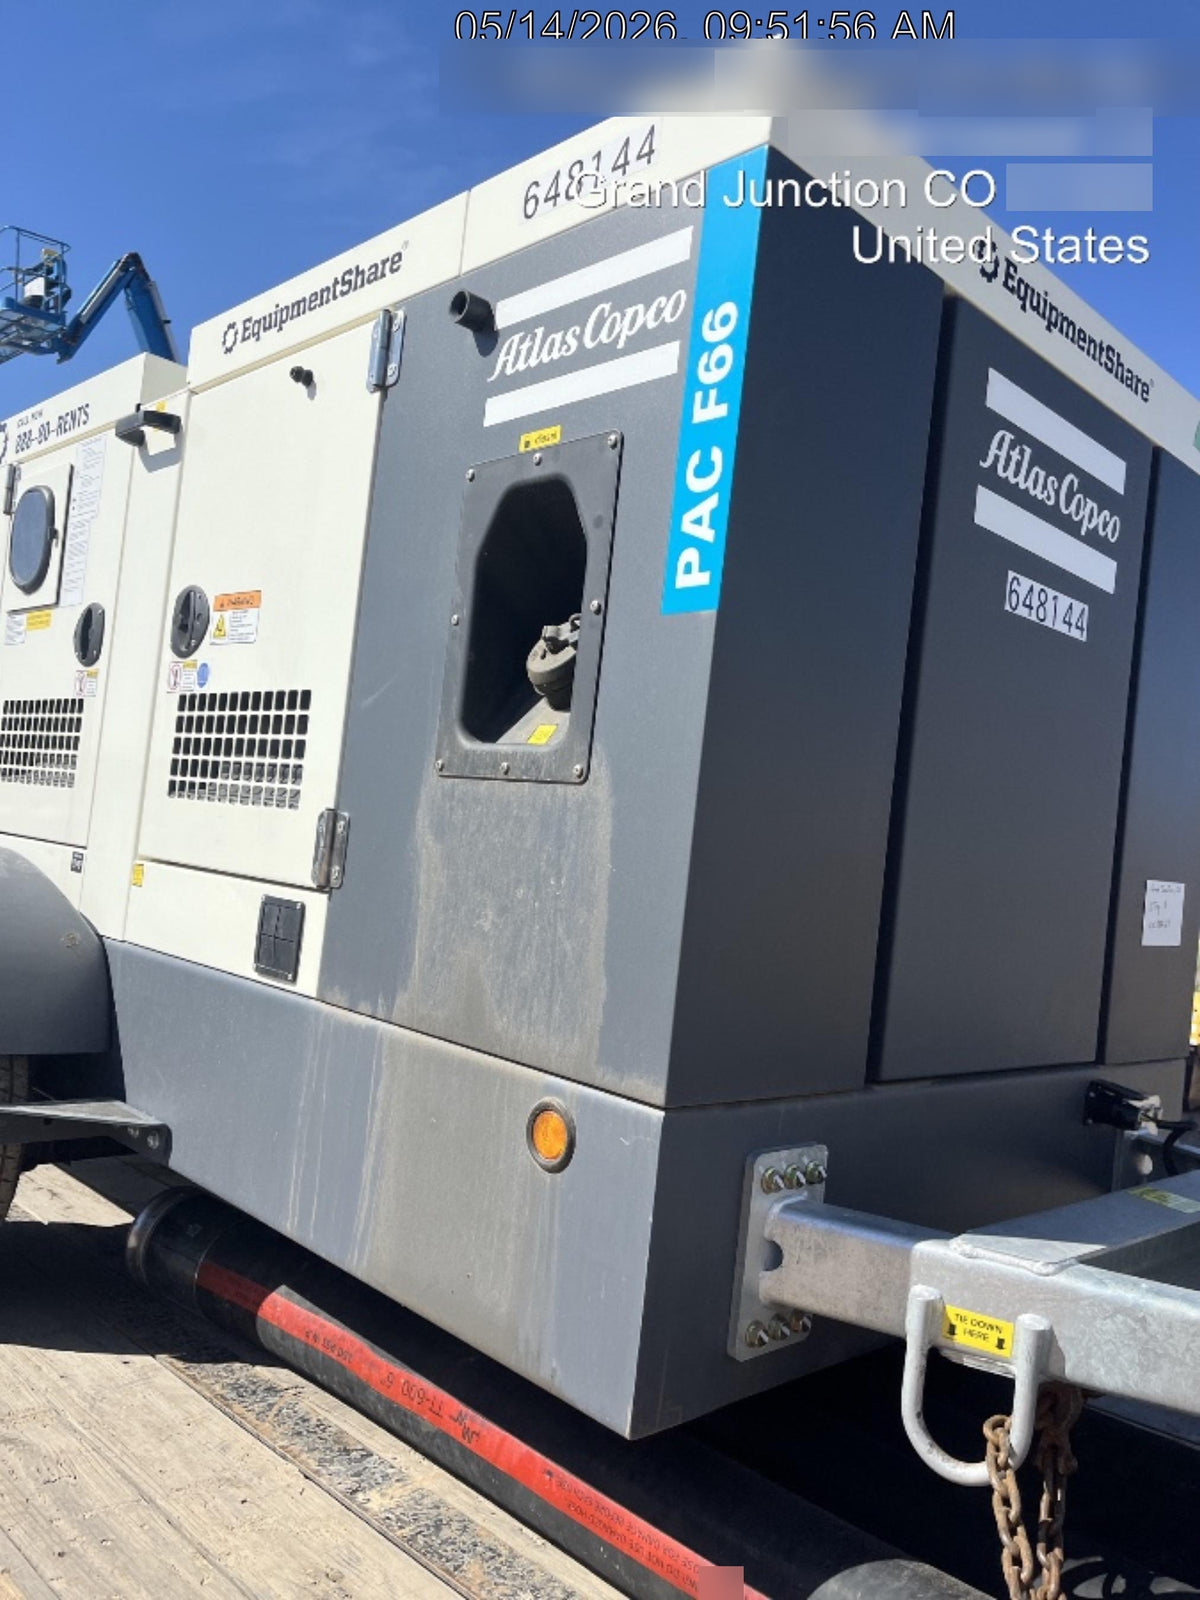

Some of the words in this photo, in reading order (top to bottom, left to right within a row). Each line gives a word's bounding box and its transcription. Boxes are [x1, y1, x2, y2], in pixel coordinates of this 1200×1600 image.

[523, 123, 656, 220] 648144
[240, 250, 404, 344] EquipmentShare
[486, 322, 582, 383] Atlas
[583, 288, 688, 349] Copco
[1002, 256, 1151, 404] EquipmentShare
[691, 301, 739, 424] F66
[675, 445, 723, 590] PAC
[980, 430, 1057, 507] Atlas
[1059, 473, 1121, 544] Copco
[1007, 576, 1087, 638] 648144
[955, 1313, 968, 1325] TIE
[970, 1318, 1003, 1334] DOWN
[963, 1328, 989, 1341] HERE
